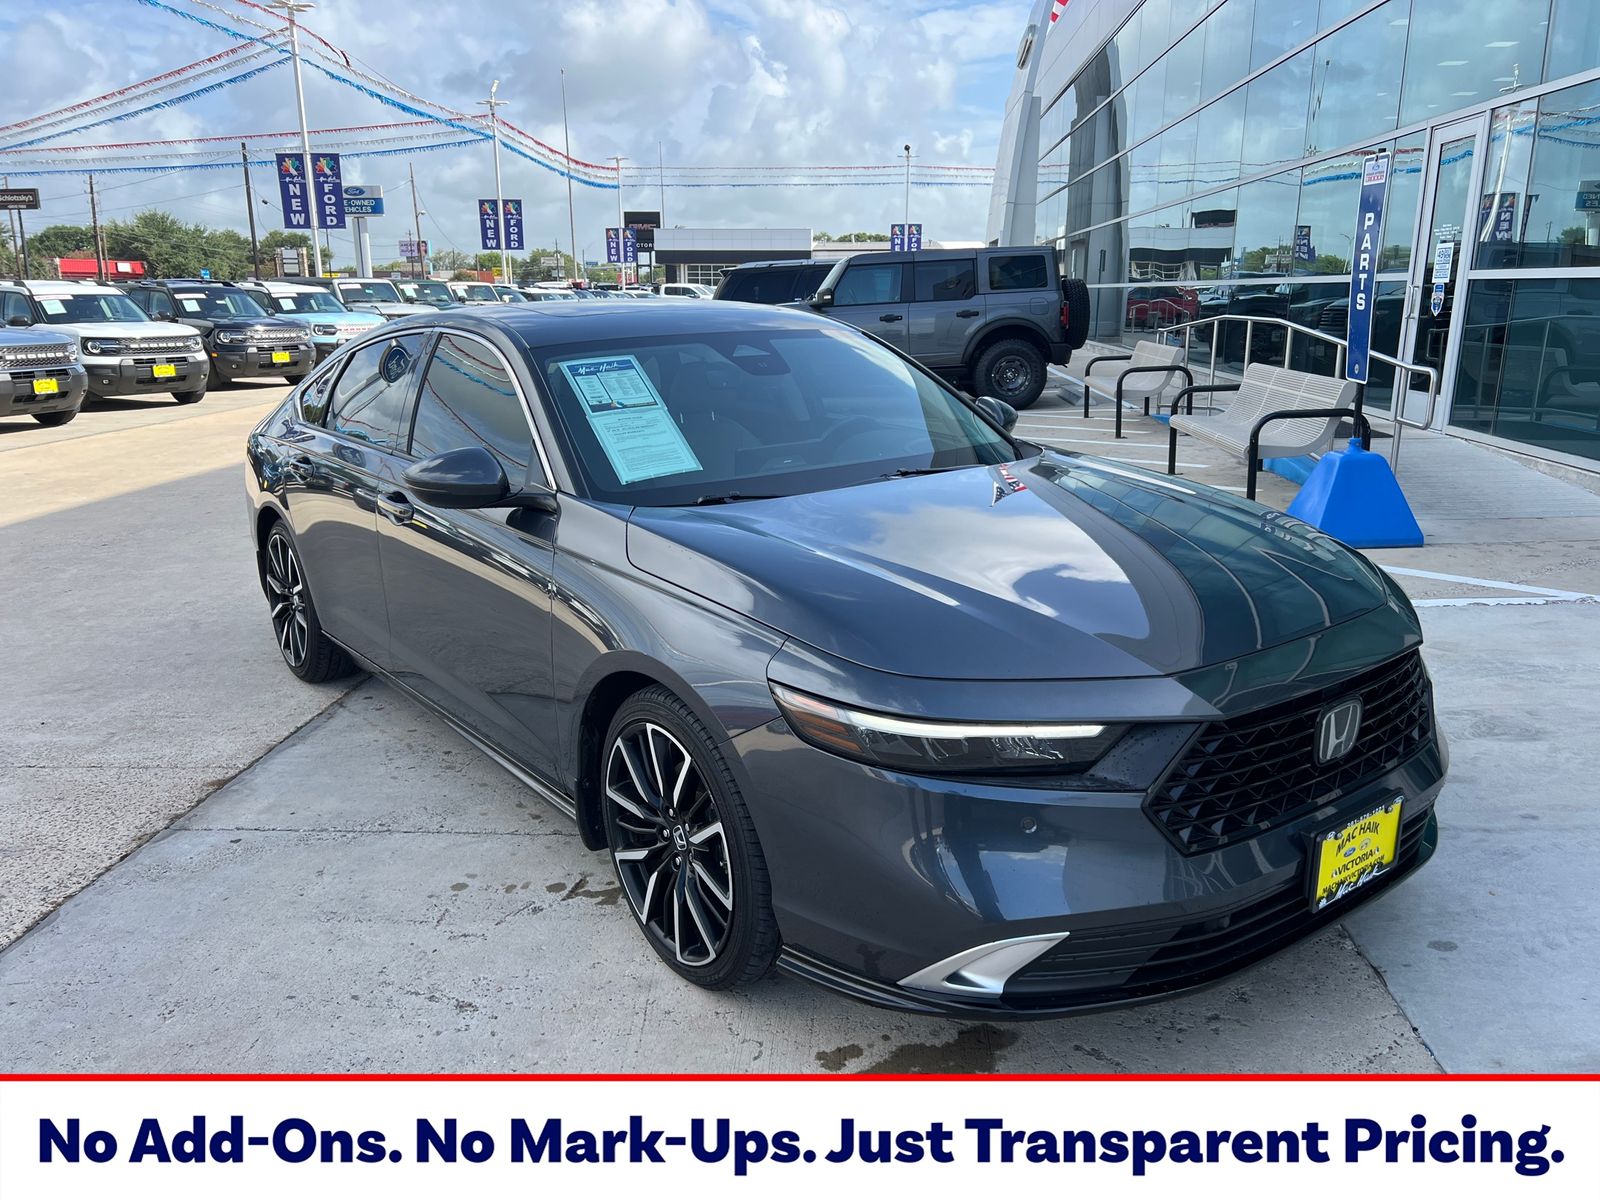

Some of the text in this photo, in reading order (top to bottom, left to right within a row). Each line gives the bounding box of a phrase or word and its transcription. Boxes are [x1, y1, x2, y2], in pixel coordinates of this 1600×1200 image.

[288, 183, 305, 225] NEW
[323, 183, 338, 226] FORD
[486, 219, 497, 248] NEW
[509, 219, 519, 248] FORD
[610, 241, 618, 262] NEW
[626, 241, 634, 262] FORD
[1356, 212, 1375, 311] PARTS
[1335, 820, 1380, 857] MAC HAIK
[1337, 849, 1373, 875] VICTORIA
